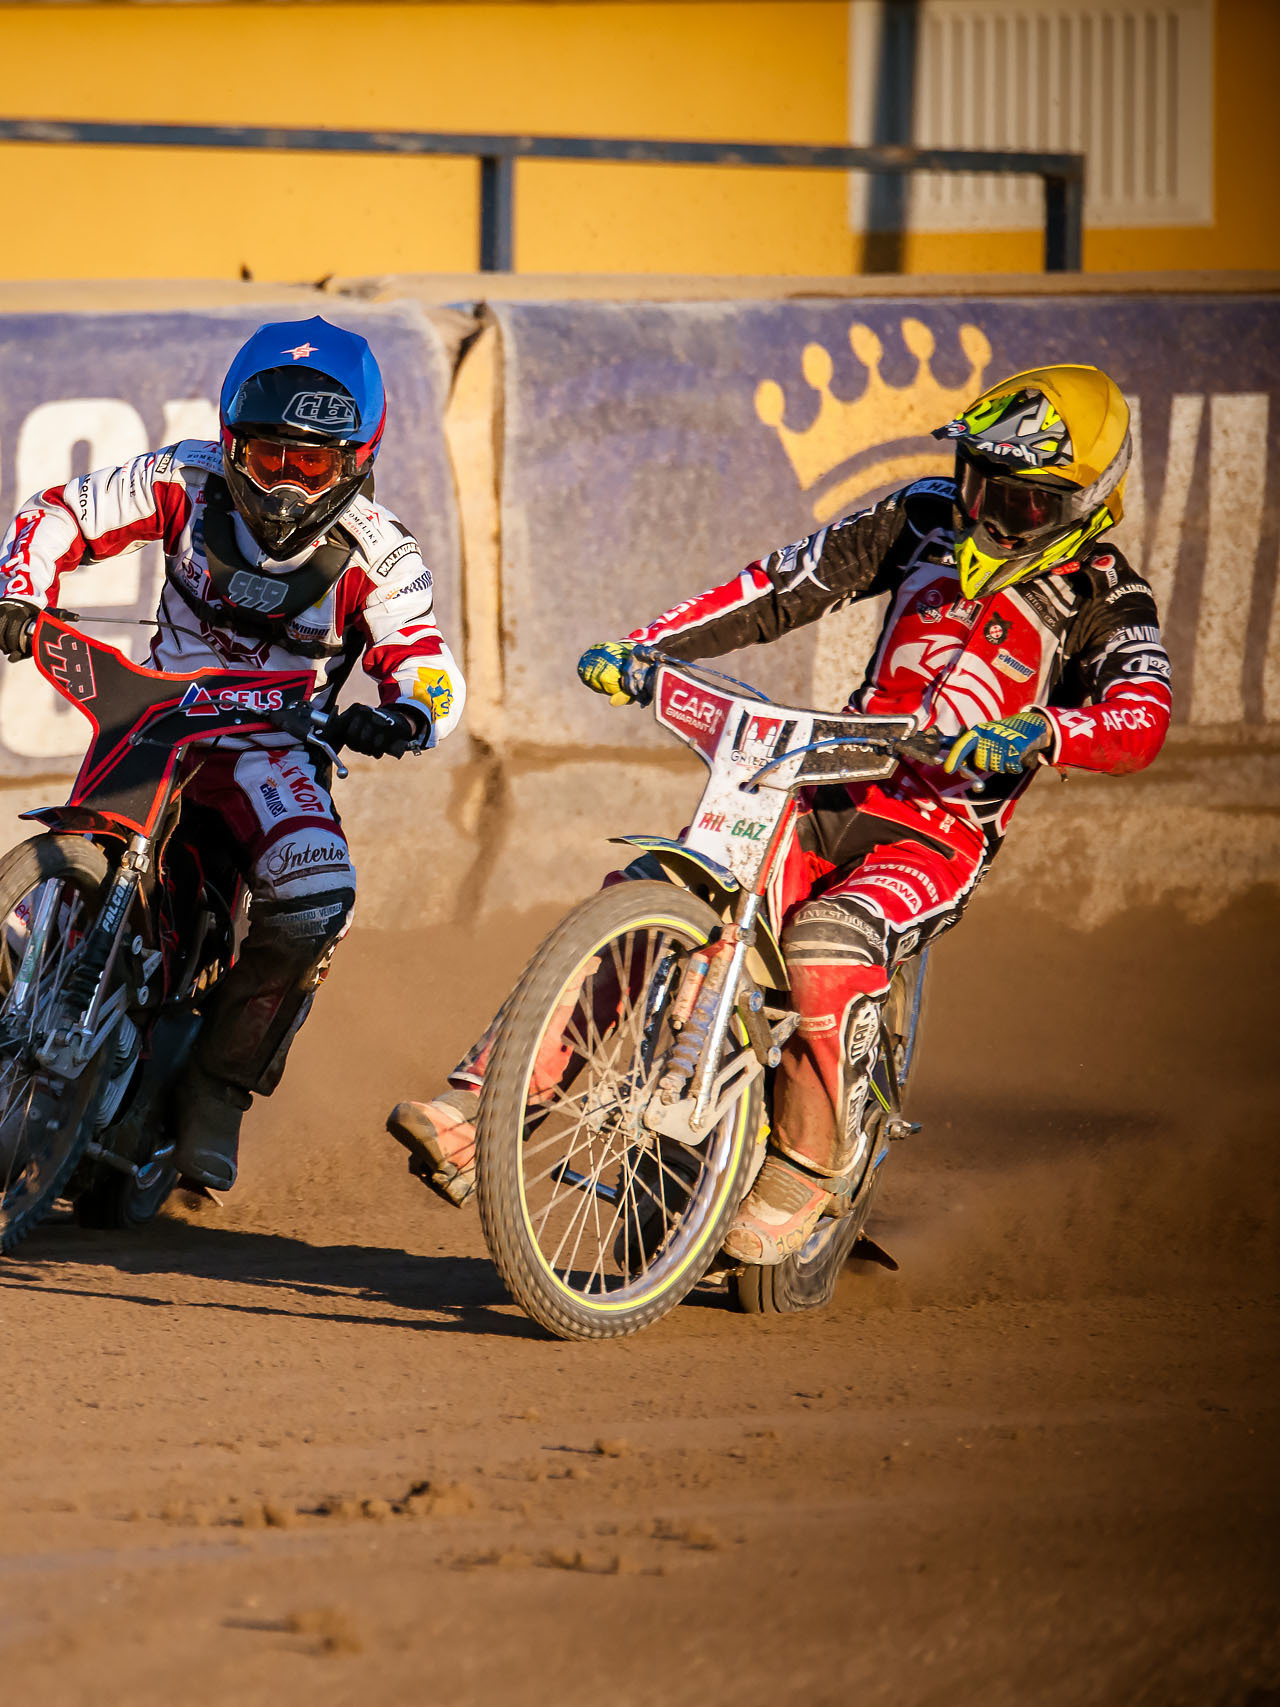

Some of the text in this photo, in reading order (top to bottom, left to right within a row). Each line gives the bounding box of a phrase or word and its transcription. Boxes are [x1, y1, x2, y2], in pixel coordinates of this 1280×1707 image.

[976, 441, 1037, 466] Airoh
[219, 690, 283, 711] SELS
[669, 689, 716, 723] CAR
[267, 841, 347, 876] Interio
